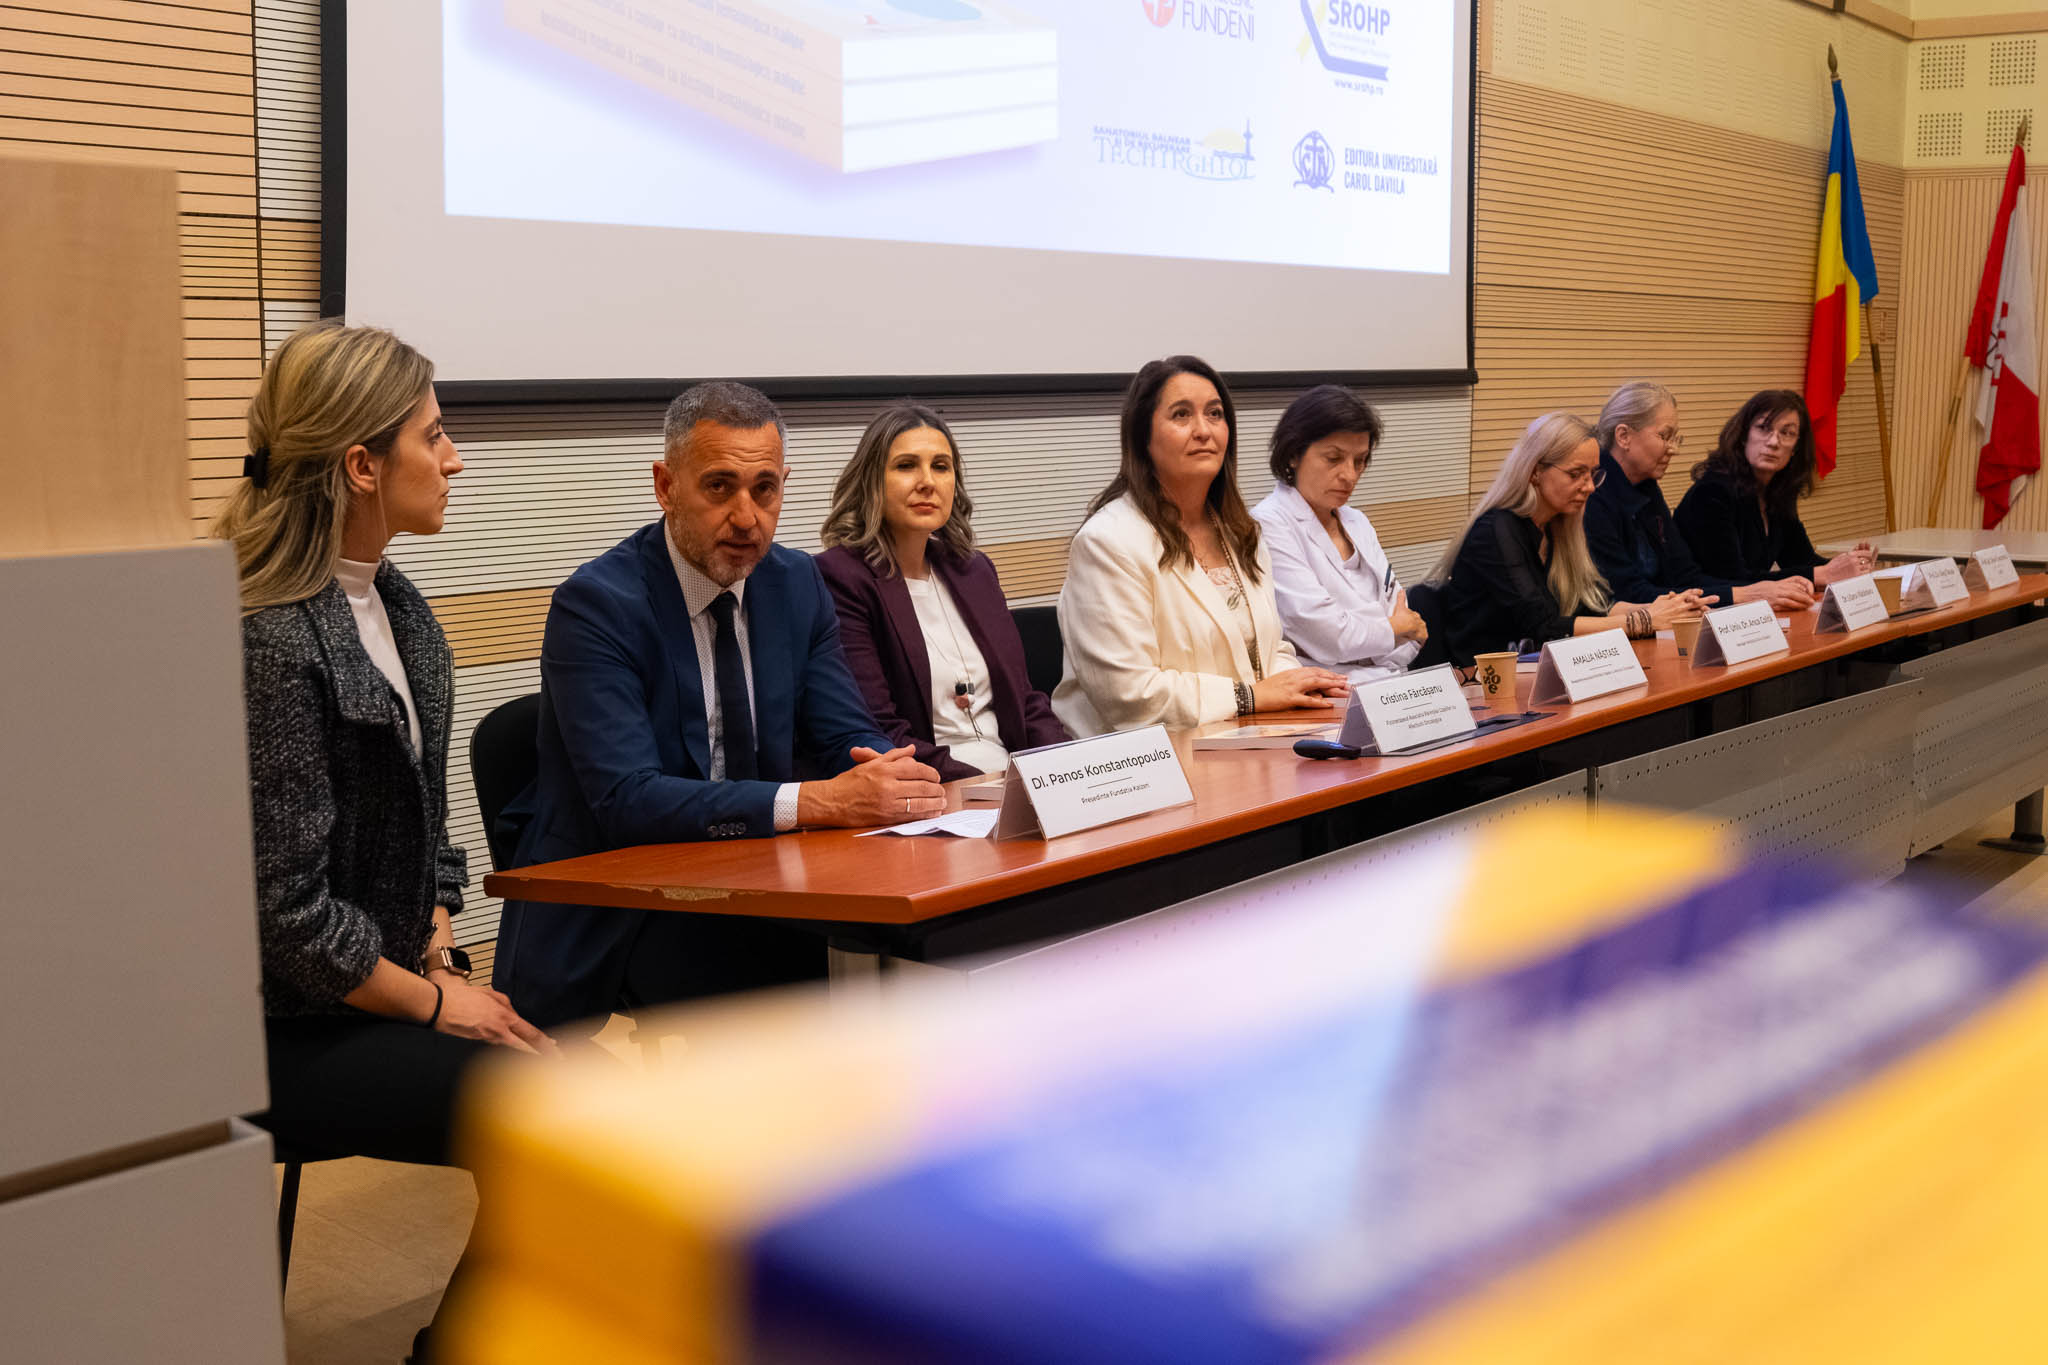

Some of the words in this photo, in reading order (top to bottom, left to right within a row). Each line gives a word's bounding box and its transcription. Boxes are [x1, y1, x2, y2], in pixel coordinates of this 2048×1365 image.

[1182, 0, 1255, 42] FUNDENI
[1328, 0, 1390, 36] SROHP
[1344, 147, 1380, 169] EDITURA
[1344, 171, 1372, 191] CAROL
[1572, 651, 1594, 666] AMALIA
[1380, 691, 1409, 705] Cristina
[1049, 769, 1085, 786] Panos
[1084, 749, 1172, 777] Konstantopoulos
